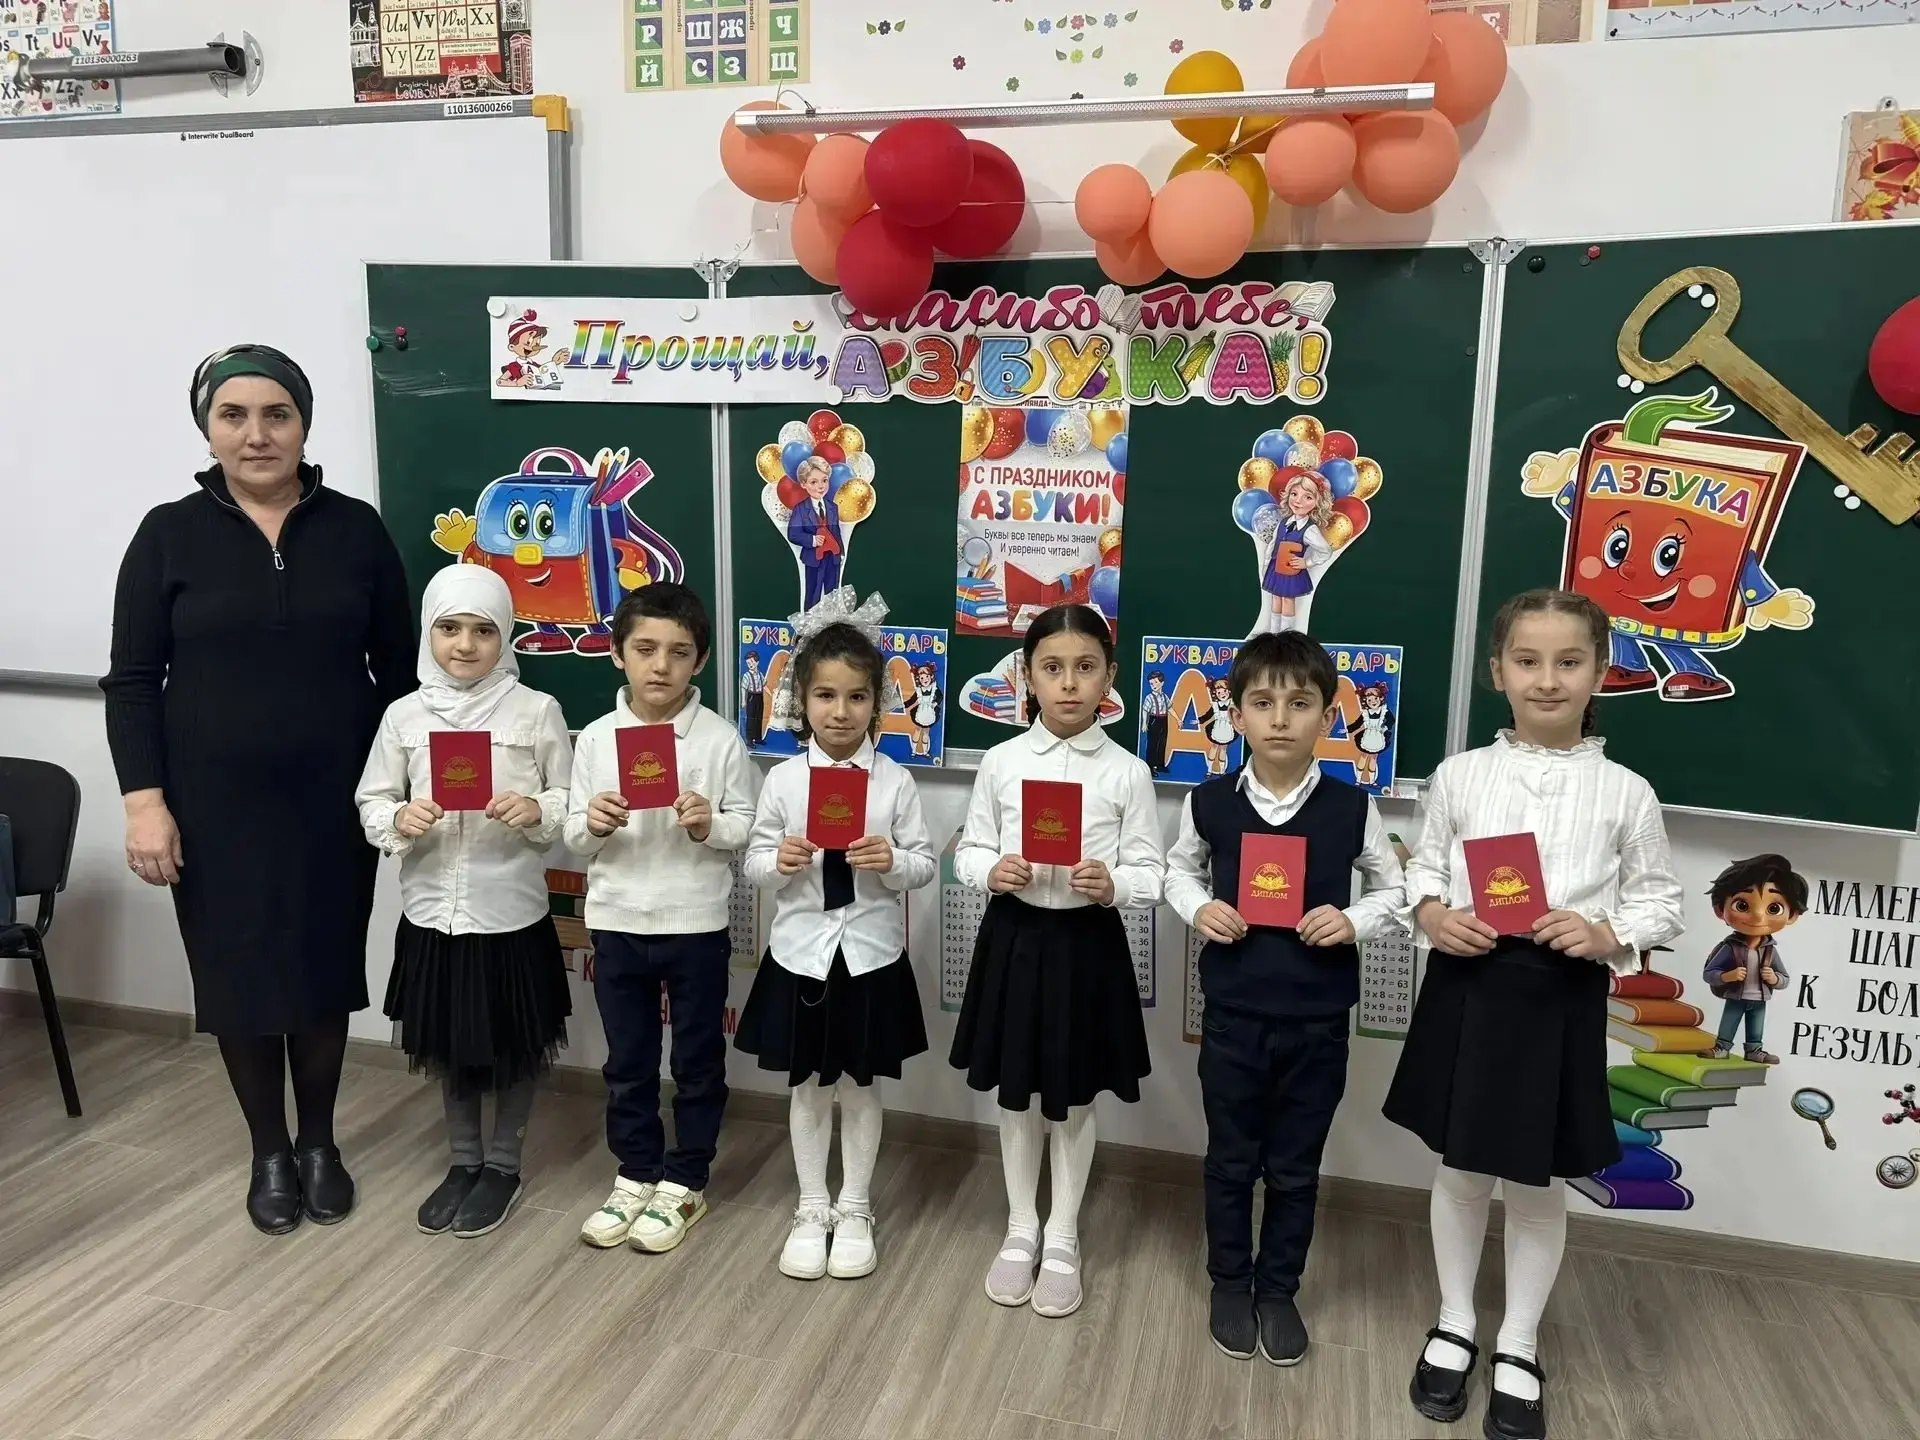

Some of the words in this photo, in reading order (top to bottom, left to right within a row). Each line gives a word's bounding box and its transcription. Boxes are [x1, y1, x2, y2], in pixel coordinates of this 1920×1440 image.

[412, 10, 436, 29] Vv
[470, 8, 494, 26] Xx
[1728, 12, 1735, 20] -1
[1769, 10, 1777, 18] -1
[1812, 7, 1820, 15] -1
[382, 13, 408, 33] Uu
[686, 21, 711, 40] Ш
[719, 19, 745, 38] Ж
[776, 15, 792, 35] Ч
[25, 34, 40, 51] Tt
[53, 32, 72, 49] Uu
[83, 29, 102, 46] Vv
[642, 24, 656, 43] Р
[75, 54, 137, 64] 110136000263
[386, 46, 407, 69] Yy
[414, 44, 436, 62] Zz
[640, 59, 658, 83] Й
[691, 58, 708, 77] С
[724, 57, 740, 75] З
[771, 52, 797, 73] Щ
[447, 102, 512, 115] 110136000266
[220, 131, 254, 139] DualBoard
[563, 319, 832, 385] Прощай,
[974, 466, 985, 484] С
[990, 466, 1110, 489] ПРАЗДНИКОМ
[1588, 462, 1752, 523] АЗБУКА
[971, 489, 1111, 525] АЗБУКИ!
[984, 528, 1009, 542] Буквы
[1011, 532, 1025, 541] все
[1027, 532, 1055, 544] теперь
[1057, 534, 1069, 543] мы
[1071, 535, 1097, 544] знаем
[1000, 542, 1006, 553] И
[1008, 545, 1046, 556] уверенно
[1048, 546, 1080, 557] читаем!
[1328, 650, 1399, 673] ВАРЬ
[631, 776, 666, 787] ДИПЛОМ
[1250, 890, 1289, 900] ДИПЛОМ
[1489, 894, 1531, 908] ДИПЛОМ
[1366, 965, 1371, 973] 9
[1397, 980, 1408, 988] 63
[1796, 974, 1819, 1010] К
[1857, 978, 1919, 1018] БОЛ
